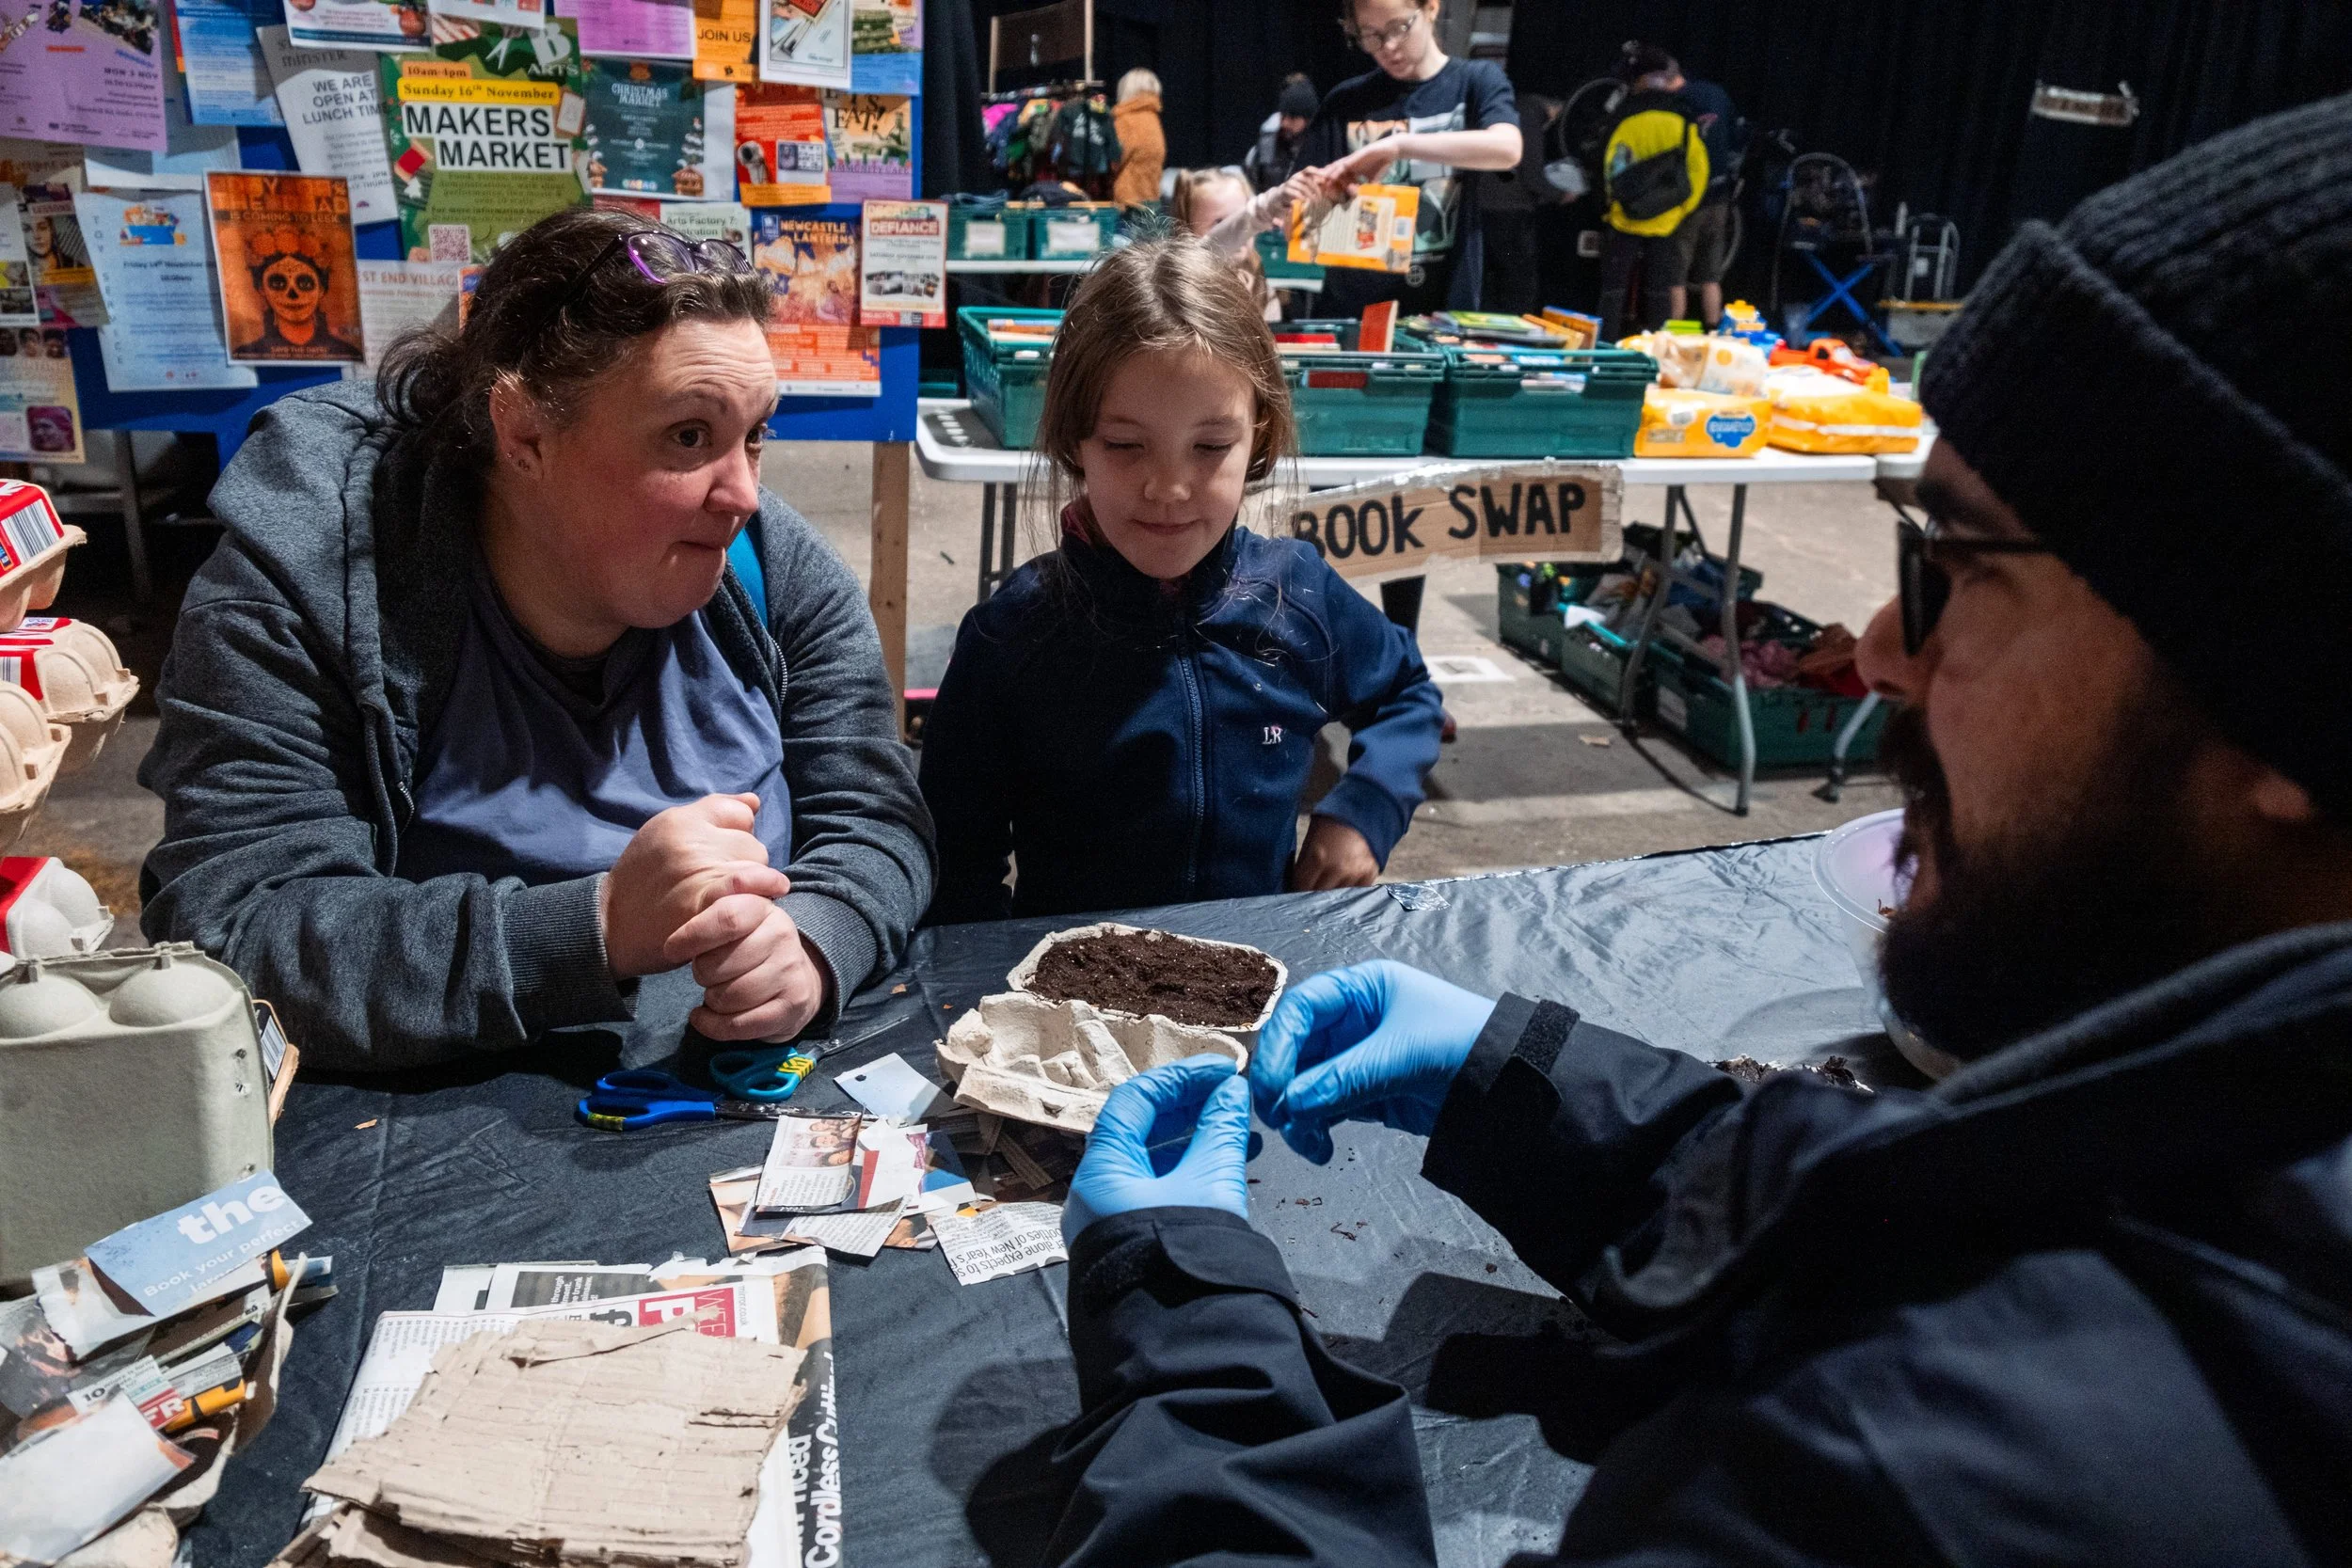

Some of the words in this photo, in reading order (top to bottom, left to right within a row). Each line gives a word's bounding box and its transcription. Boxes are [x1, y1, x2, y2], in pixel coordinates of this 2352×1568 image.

[698, 29, 728, 41] JOIN
[733, 31, 751, 42] US
[312, 79, 338, 93] WE
[342, 74, 373, 90] ARE
[404, 84, 454, 100] Sunday
[486, 87, 554, 99] November
[312, 94, 354, 107] OPEN
[358, 88, 378, 103] AT
[302, 105, 353, 124] LUNCH
[405, 104, 550, 137] MAKERS
[438, 140, 569, 169] MARKET
[780, 219, 848, 233] NEWCASTLE
[871, 221, 938, 234] DEFIANCE
[793, 231, 855, 245] LANTERNS
[1293, 493, 1425, 560] BOOK
[1448, 482, 1586, 540] SWAP
[177, 1185, 286, 1244] the
[991, 1239, 1014, 1254] New
[1015, 1234, 1025, 1246] of
[1024, 1240, 1053, 1257] alone
[143, 1270, 193, 1298] Book
[195, 1249, 234, 1274] your
[240, 1221, 300, 1254] perfect
[956, 1247, 989, 1265] Year's
[979, 1249, 1023, 1271] expects
[966, 1263, 980, 1275] to
[84, 1386, 106, 1402] 10
[803, 1446, 841, 1568] Cordless
